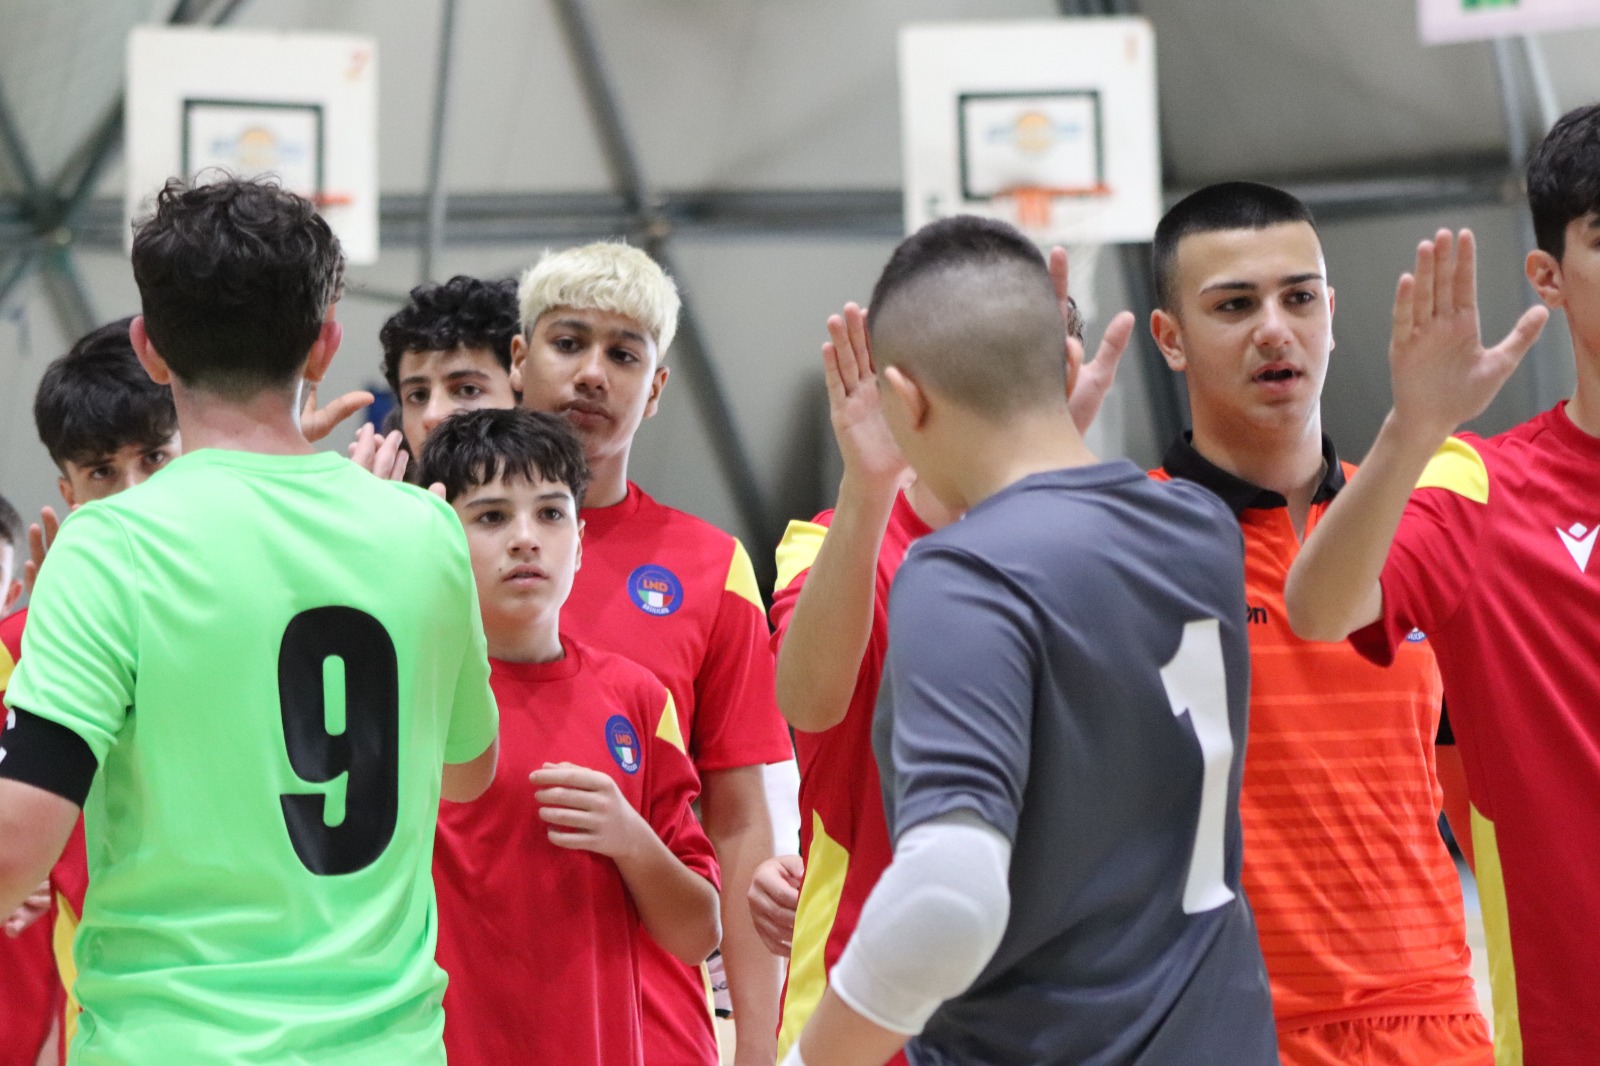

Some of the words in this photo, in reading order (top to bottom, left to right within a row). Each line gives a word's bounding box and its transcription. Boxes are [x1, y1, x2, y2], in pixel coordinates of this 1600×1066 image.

[643, 579, 668, 593] LND
[278, 605, 398, 876] 9
[1159, 618, 1235, 914] 1
